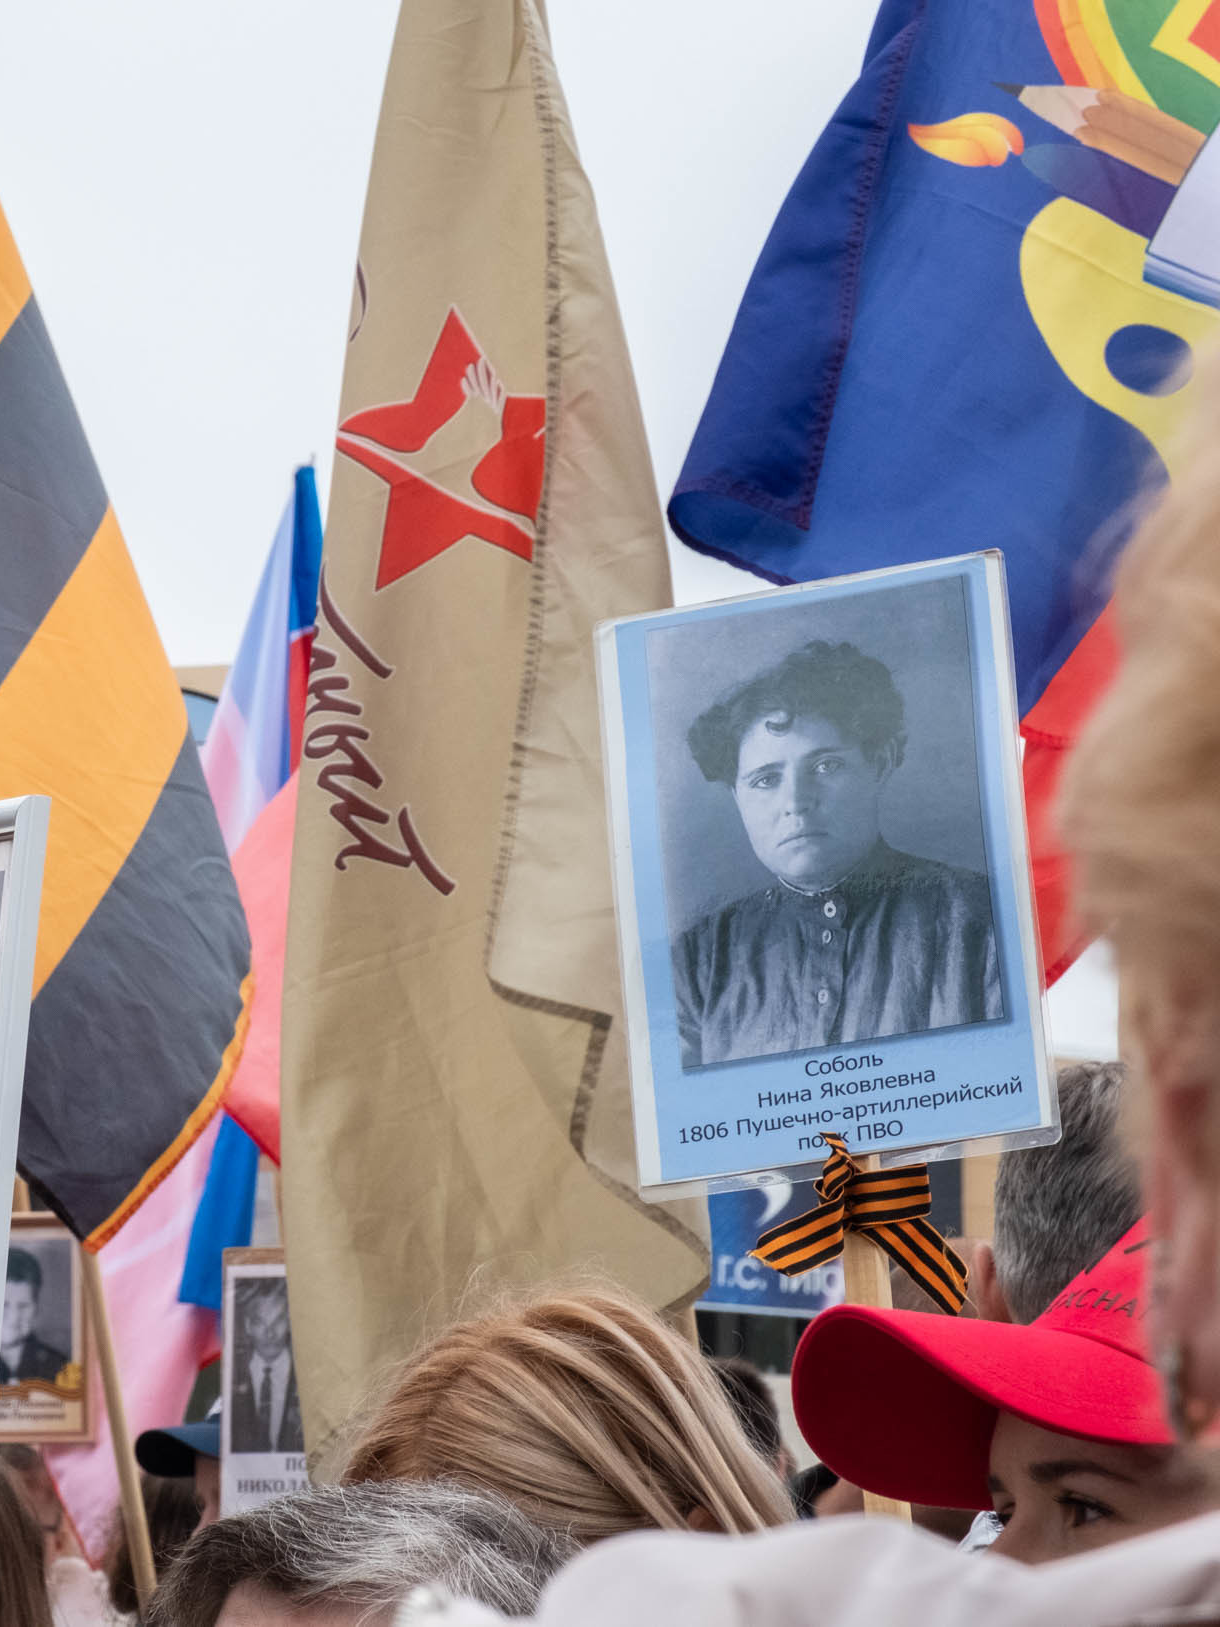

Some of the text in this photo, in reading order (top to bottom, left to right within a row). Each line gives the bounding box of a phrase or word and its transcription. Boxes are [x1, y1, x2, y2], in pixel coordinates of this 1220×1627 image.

[805, 1054, 883, 1077] Соболь
[758, 1069, 936, 1108] Нина Яковлевна
[679, 1075, 1023, 1144] 1806 Пушечно-артиллерийский
[798, 1120, 904, 1151] пок ПВО
